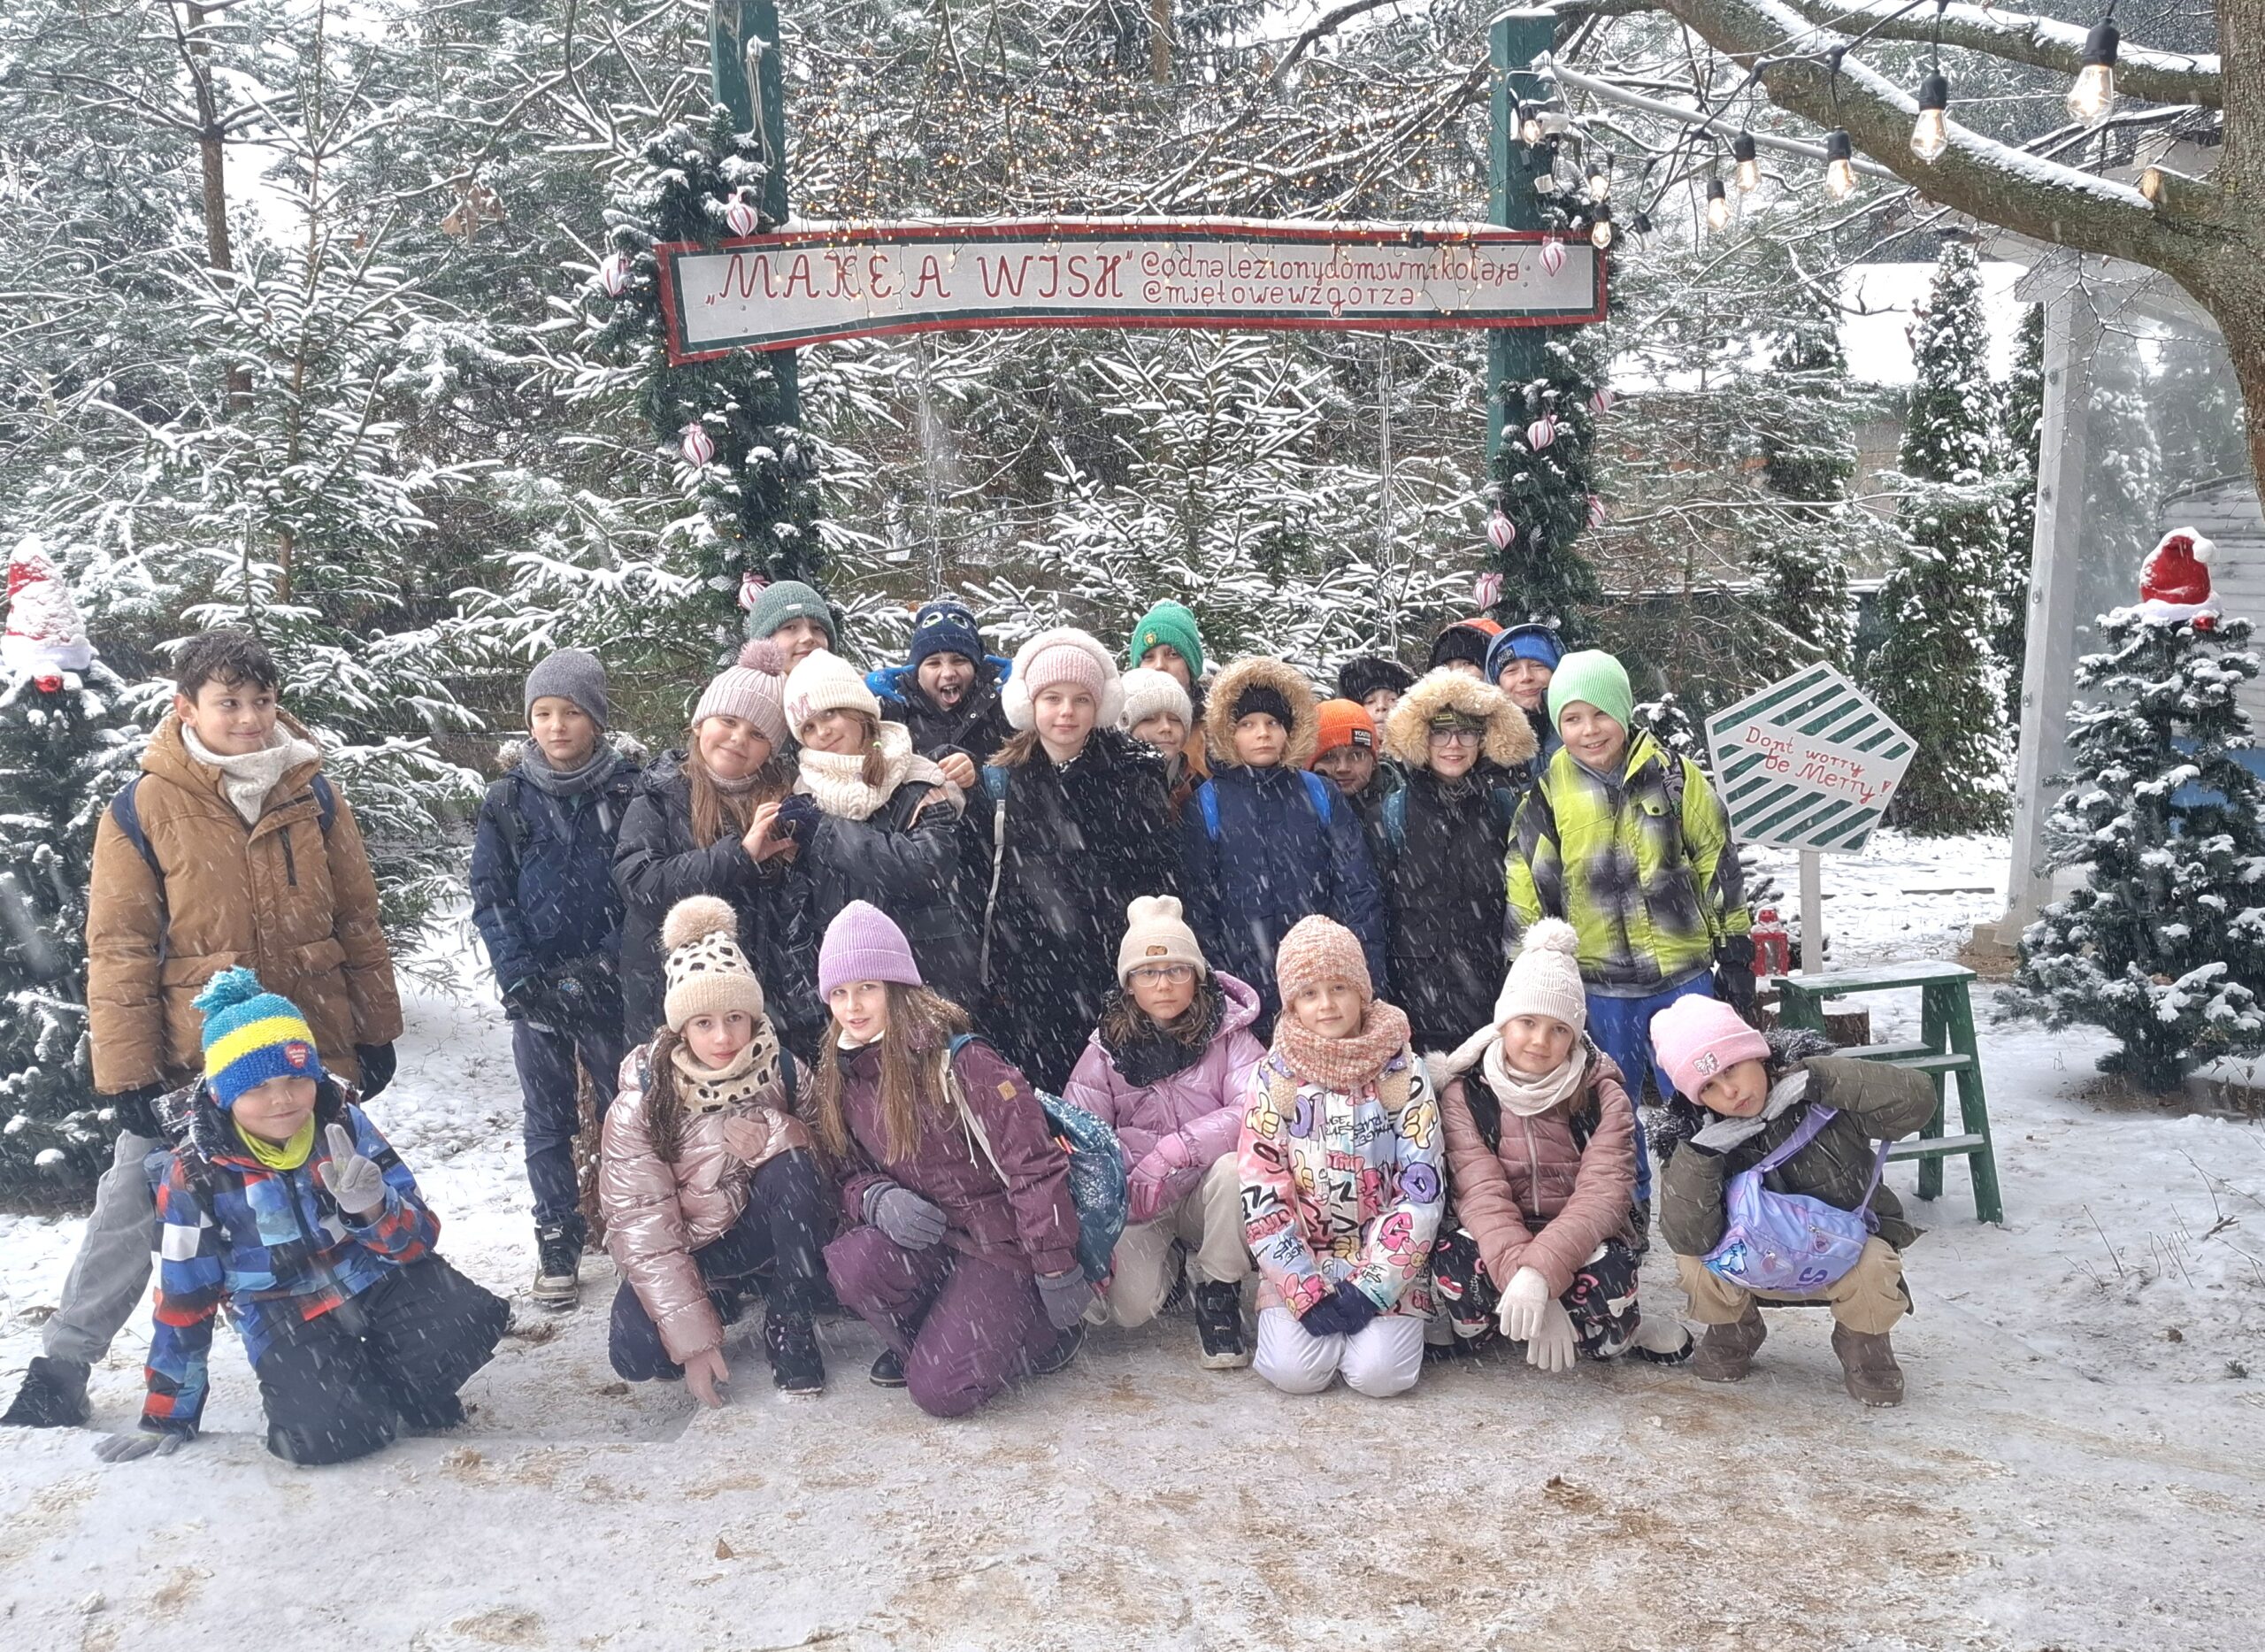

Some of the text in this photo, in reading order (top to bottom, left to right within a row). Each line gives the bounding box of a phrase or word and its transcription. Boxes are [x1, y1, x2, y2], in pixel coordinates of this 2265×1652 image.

[910, 255, 951, 298] A
[1746, 726, 1865, 778] Dont worry
[1764, 748, 1790, 772] be
